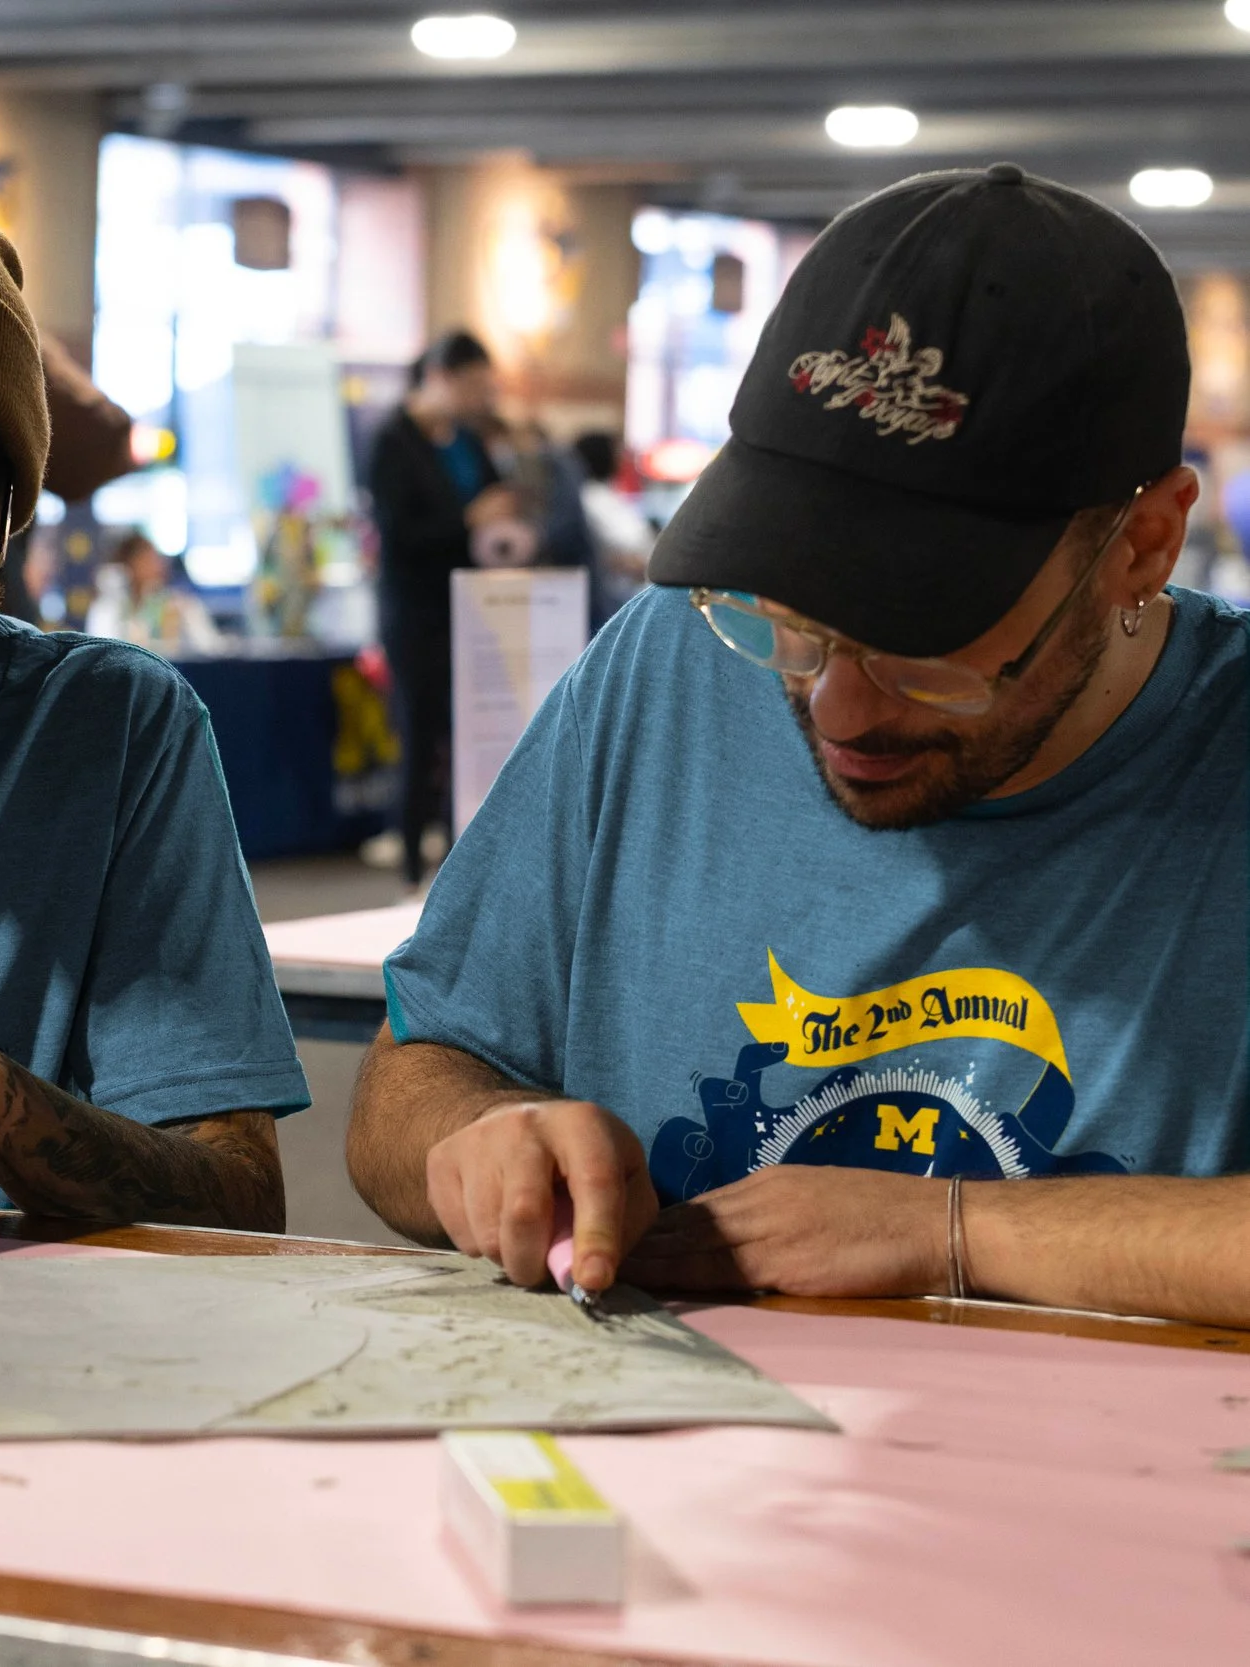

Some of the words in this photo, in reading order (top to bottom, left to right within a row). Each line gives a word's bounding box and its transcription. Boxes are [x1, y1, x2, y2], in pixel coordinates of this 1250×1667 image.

[802, 1006, 861, 1054] The
[865, 998, 912, 1042] 2nd
[920, 987, 1029, 1031] Annual
[874, 1104, 941, 1156] M
